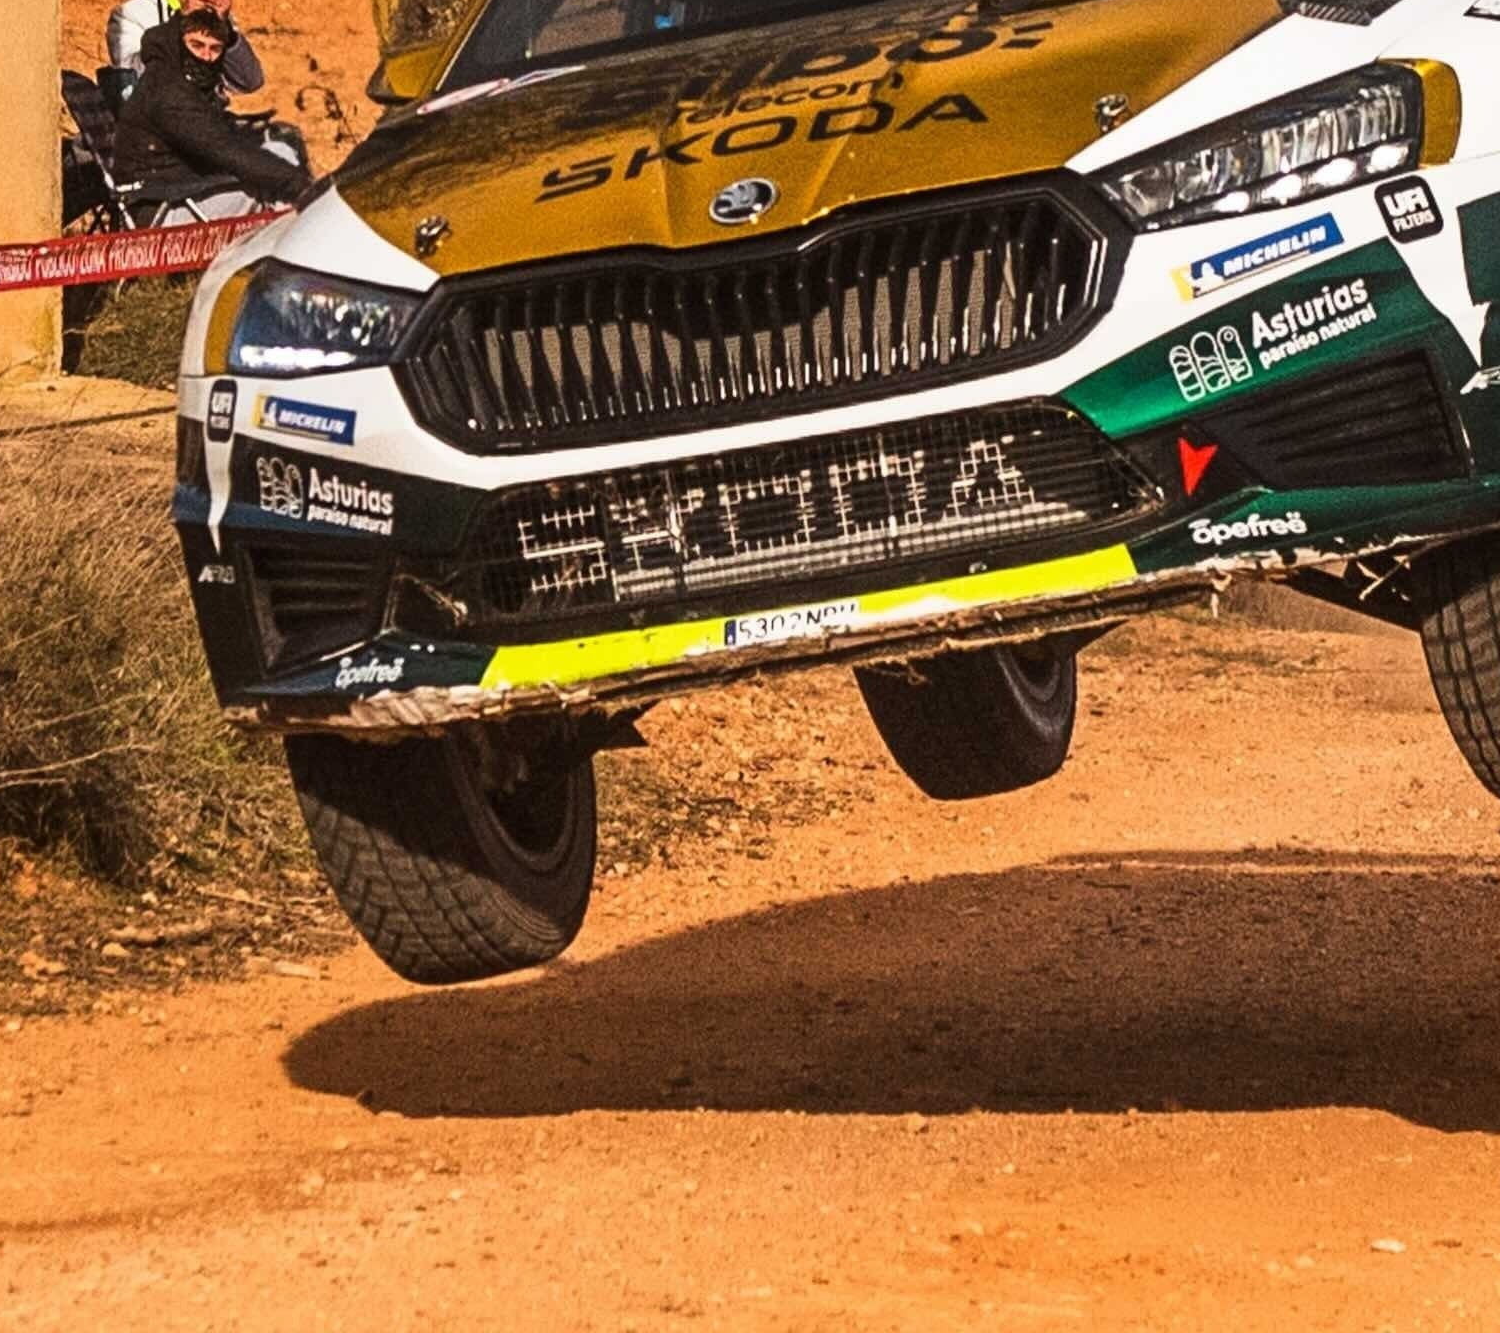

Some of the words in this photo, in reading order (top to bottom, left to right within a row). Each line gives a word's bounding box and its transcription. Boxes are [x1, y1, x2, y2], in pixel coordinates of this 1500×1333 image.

[1222, 224, 1328, 278] MICHELIN
[1250, 277, 1370, 349] Asturias
[1317, 303, 1378, 342] natural
[278, 408, 347, 435] MICHELIN
[308, 466, 394, 516] Asturias
[349, 514, 394, 536] natural
